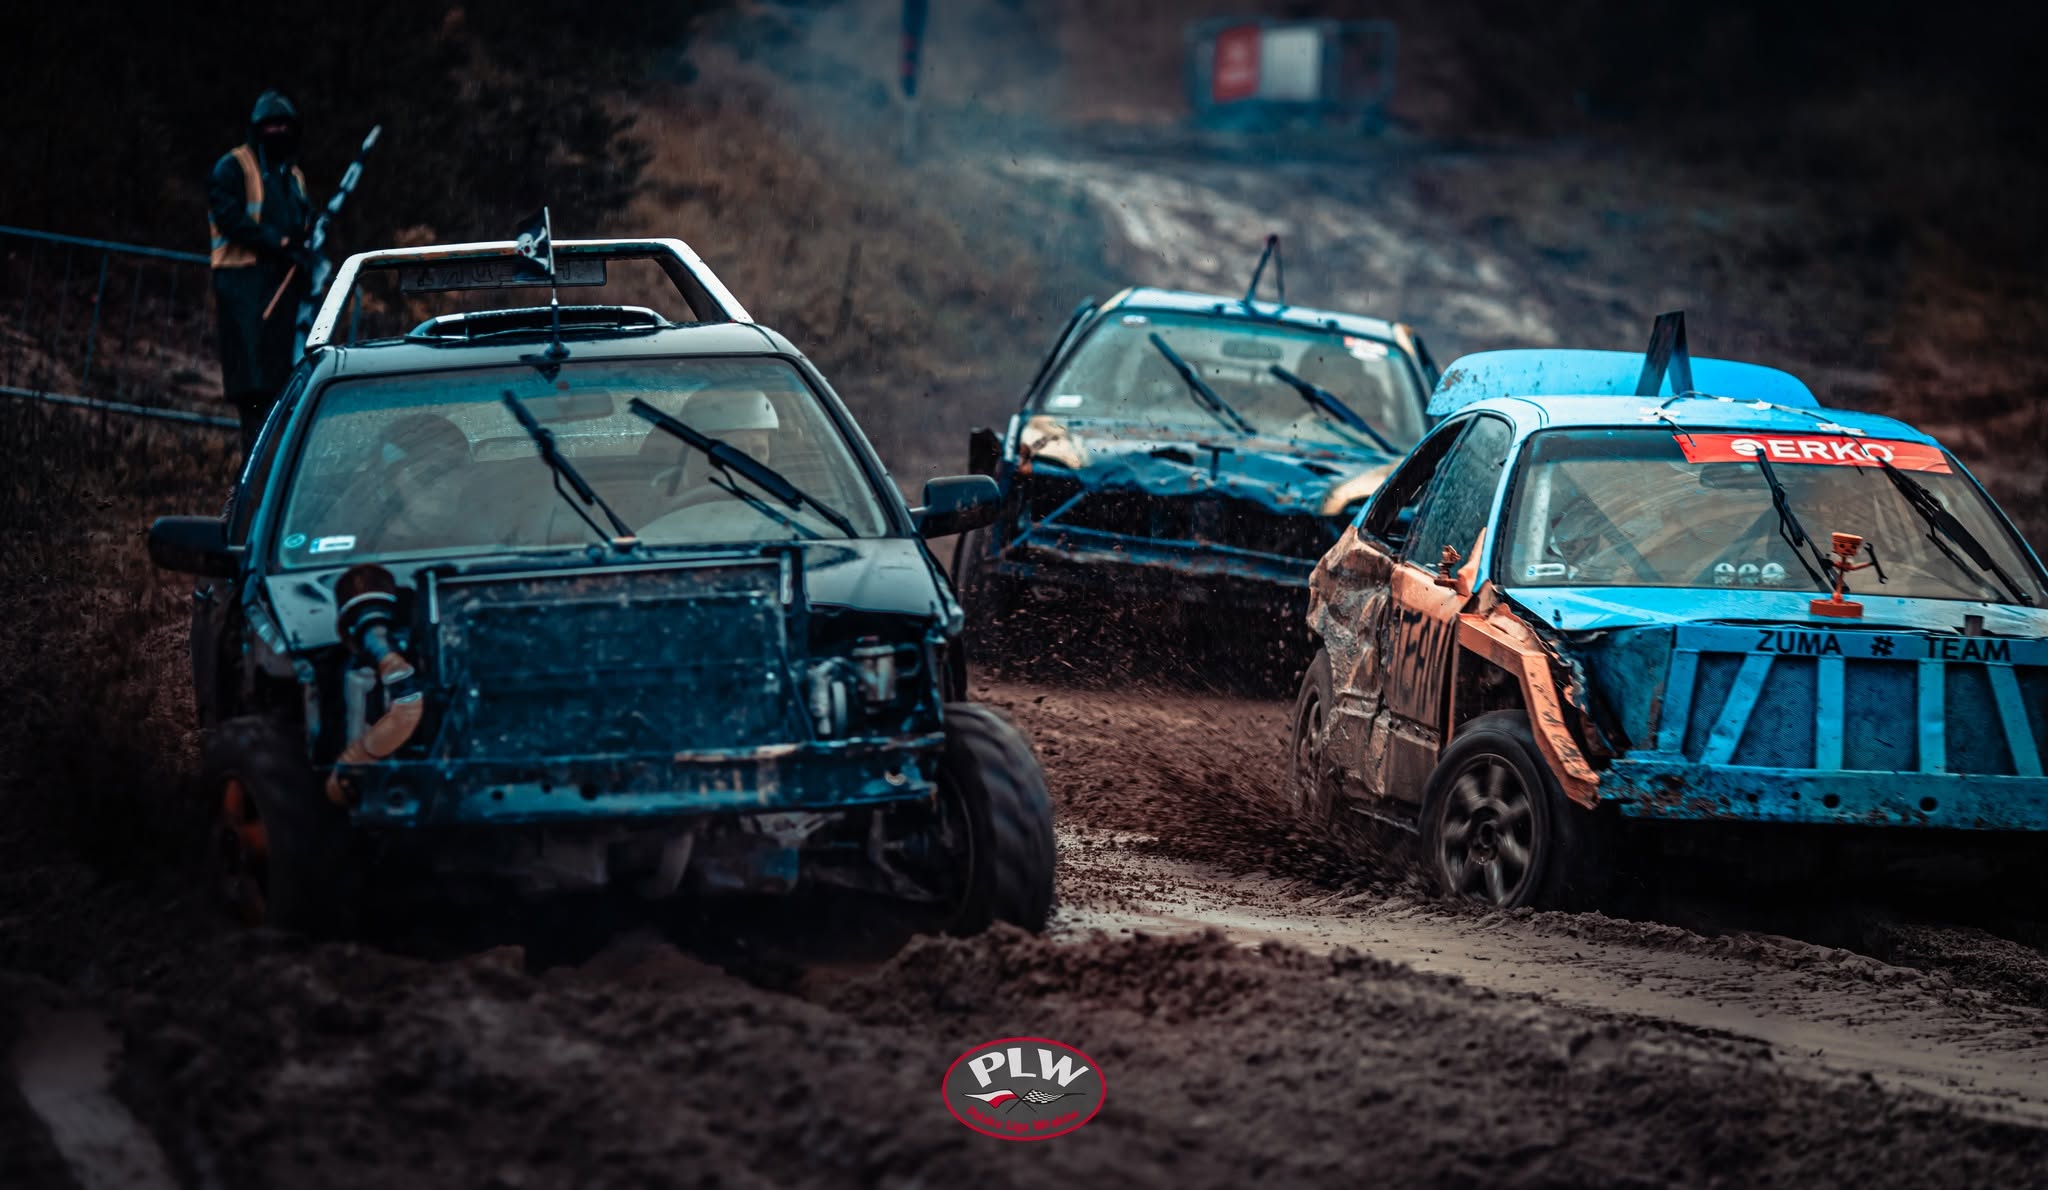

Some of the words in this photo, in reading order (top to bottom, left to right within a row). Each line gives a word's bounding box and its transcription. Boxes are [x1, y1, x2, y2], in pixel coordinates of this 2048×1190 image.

[1756, 630, 1843, 655] ZUMA
[1870, 635, 1895, 657] #
[1924, 635, 2011, 661] TEAM
